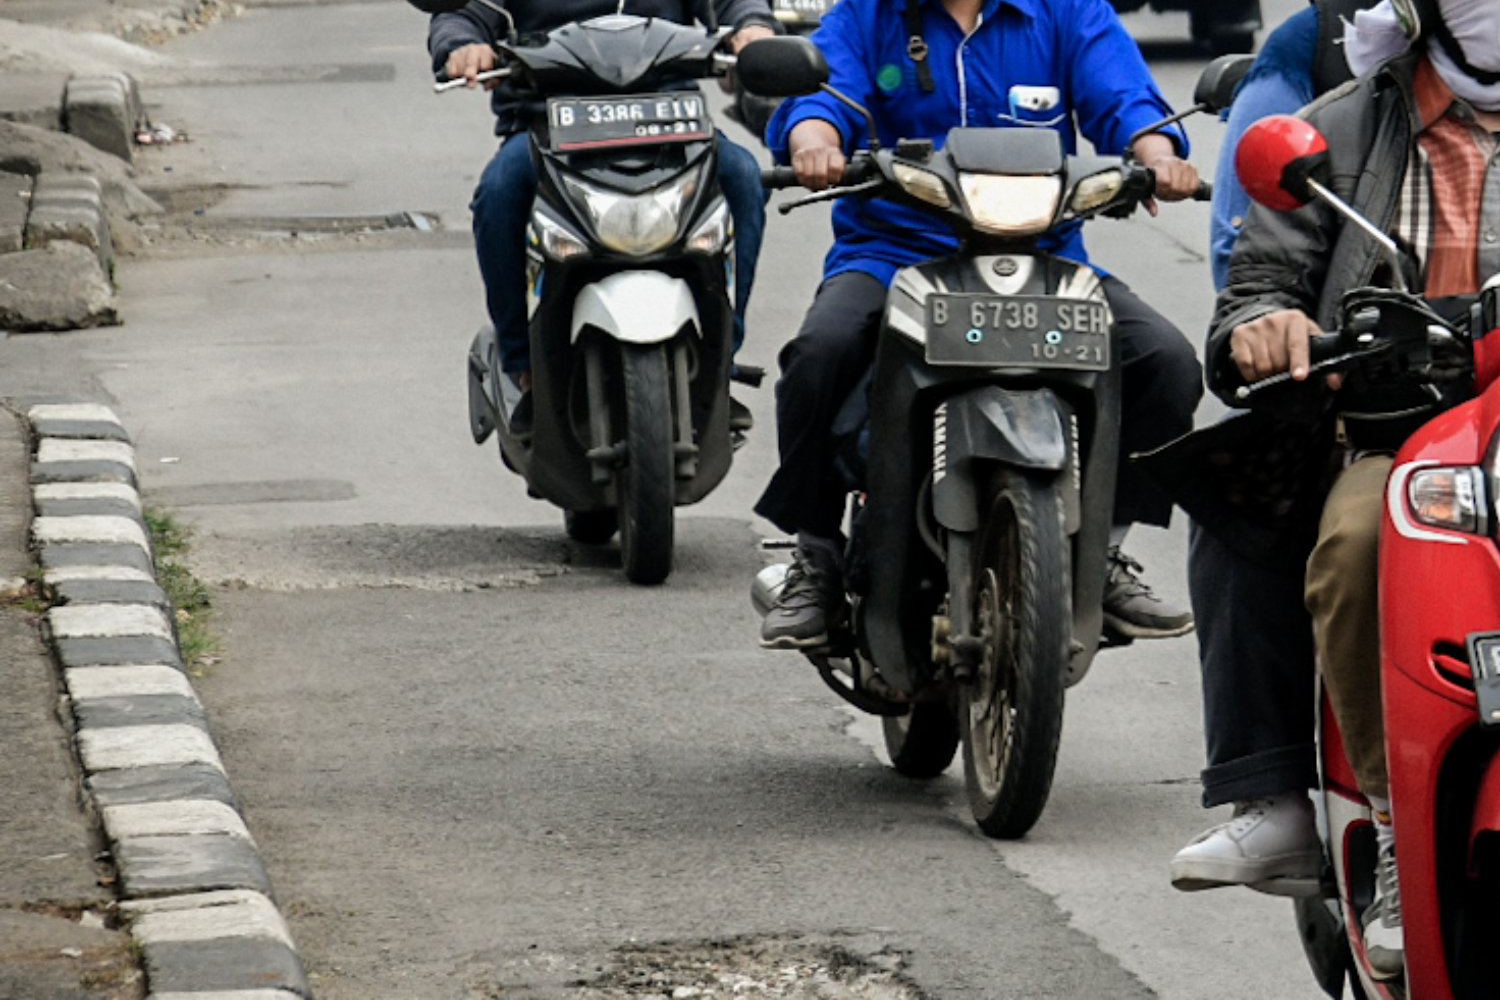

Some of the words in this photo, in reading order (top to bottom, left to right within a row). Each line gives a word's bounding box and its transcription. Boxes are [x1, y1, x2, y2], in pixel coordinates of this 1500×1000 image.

[560, 106, 575, 126] B
[933, 300, 948, 325] B
[970, 302, 1039, 329] 6738
[1057, 304, 1105, 335] SEH
